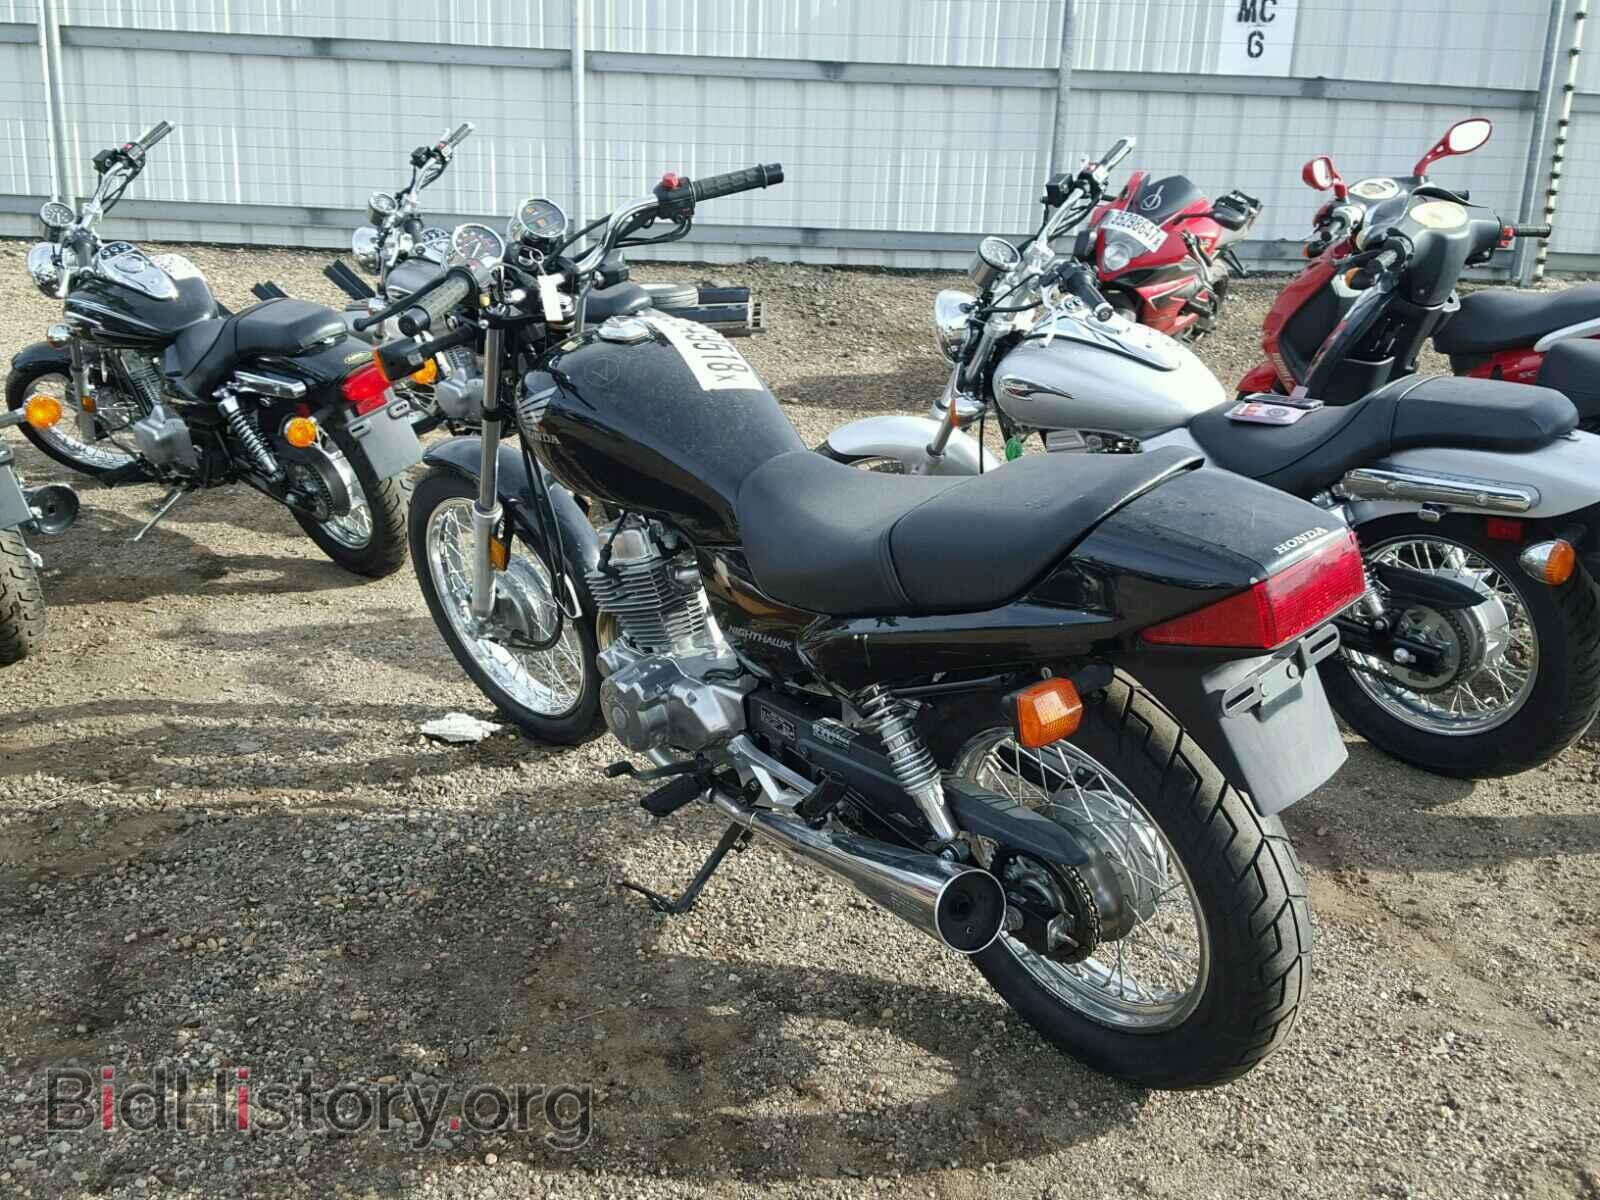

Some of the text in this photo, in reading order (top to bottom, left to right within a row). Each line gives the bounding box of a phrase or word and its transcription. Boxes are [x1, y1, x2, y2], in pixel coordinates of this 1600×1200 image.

[1237, 0, 1277, 23] MC
[1273, 527, 1329, 555] HONDA
[728, 625, 793, 651] NIGHTHAWK
